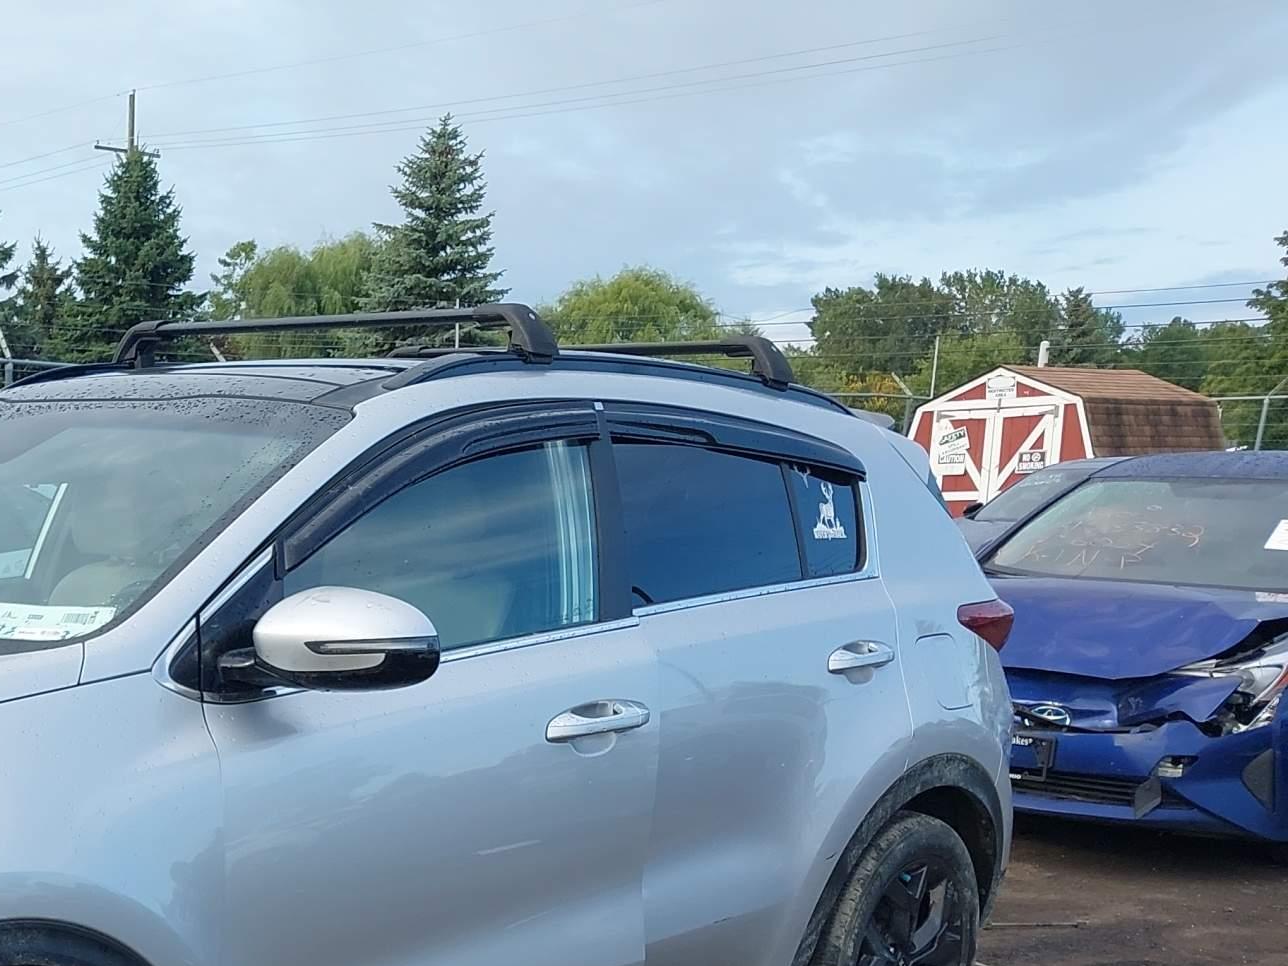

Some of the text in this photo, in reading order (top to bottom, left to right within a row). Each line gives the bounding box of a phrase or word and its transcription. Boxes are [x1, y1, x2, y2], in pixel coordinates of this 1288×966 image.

[939, 455, 965, 463] CAUTION
[1022, 453, 1031, 461] NO
[1019, 461, 1044, 470] SMOKING
